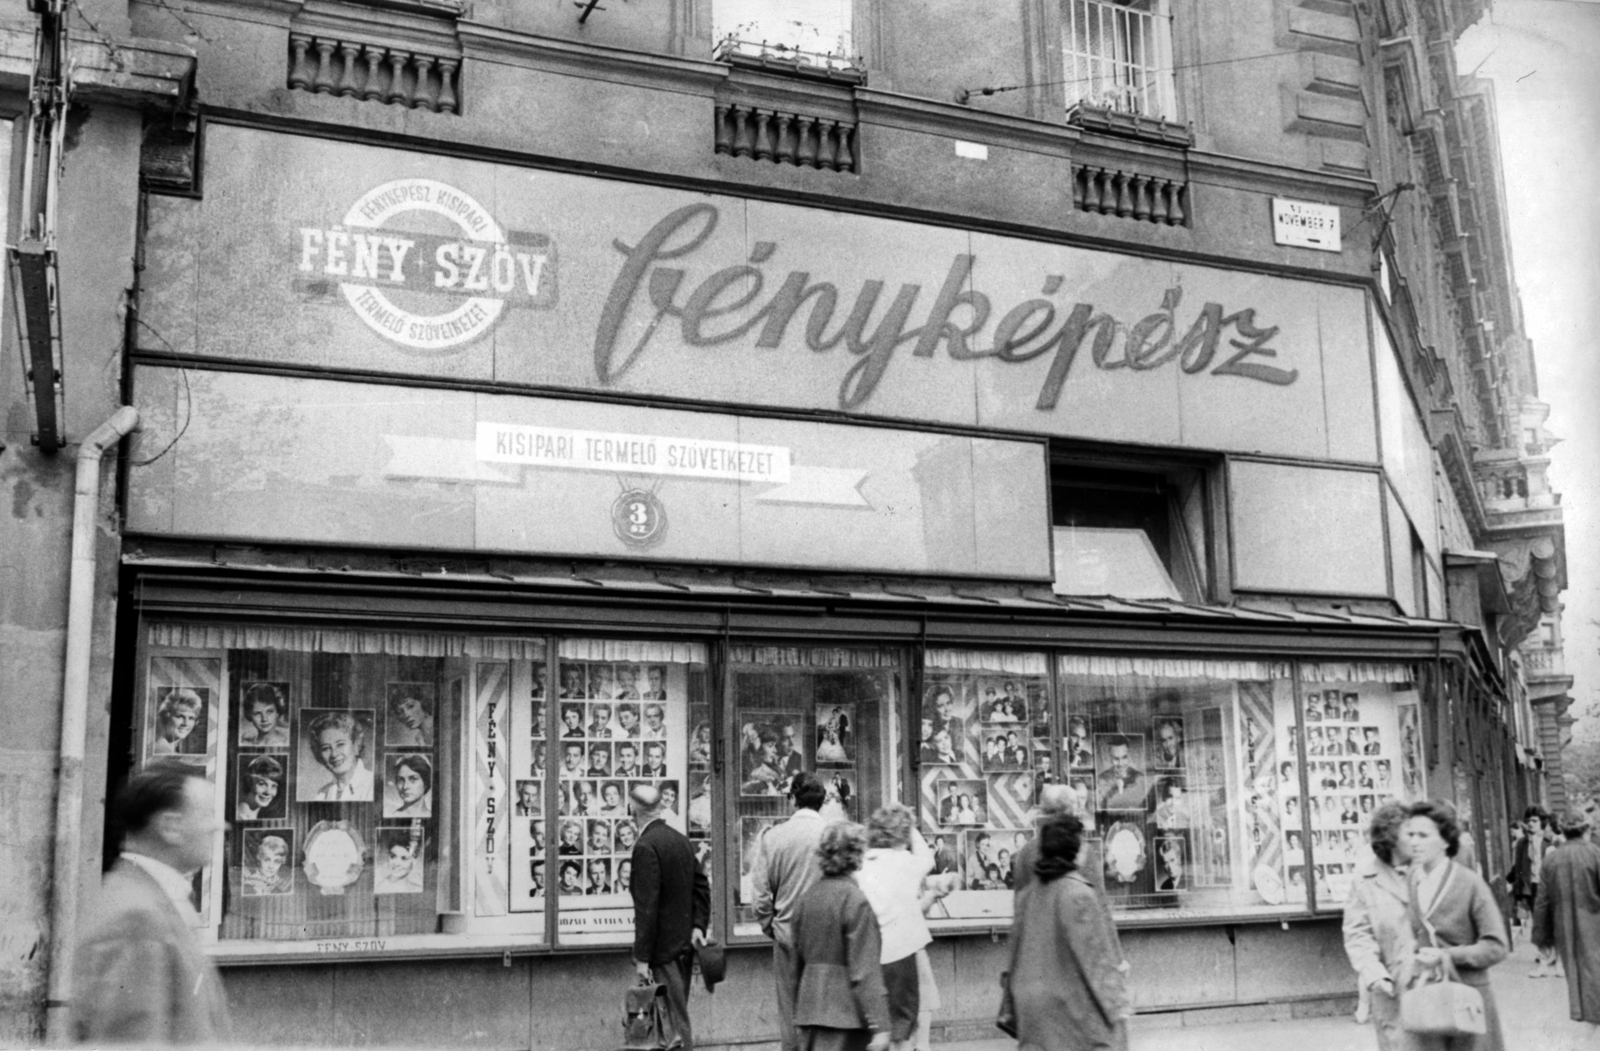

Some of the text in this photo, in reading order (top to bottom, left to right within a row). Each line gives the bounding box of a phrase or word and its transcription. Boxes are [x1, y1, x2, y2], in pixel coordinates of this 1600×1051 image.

[437, 189, 488, 233] KISIPARI
[1278, 212, 1324, 231] NOVEMBER
[299, 225, 547, 296] FÉNY SZÖV
[594, 202, 1298, 410] fényképész
[496, 431, 574, 459] KISIPARI
[630, 502, 647, 524] 3
